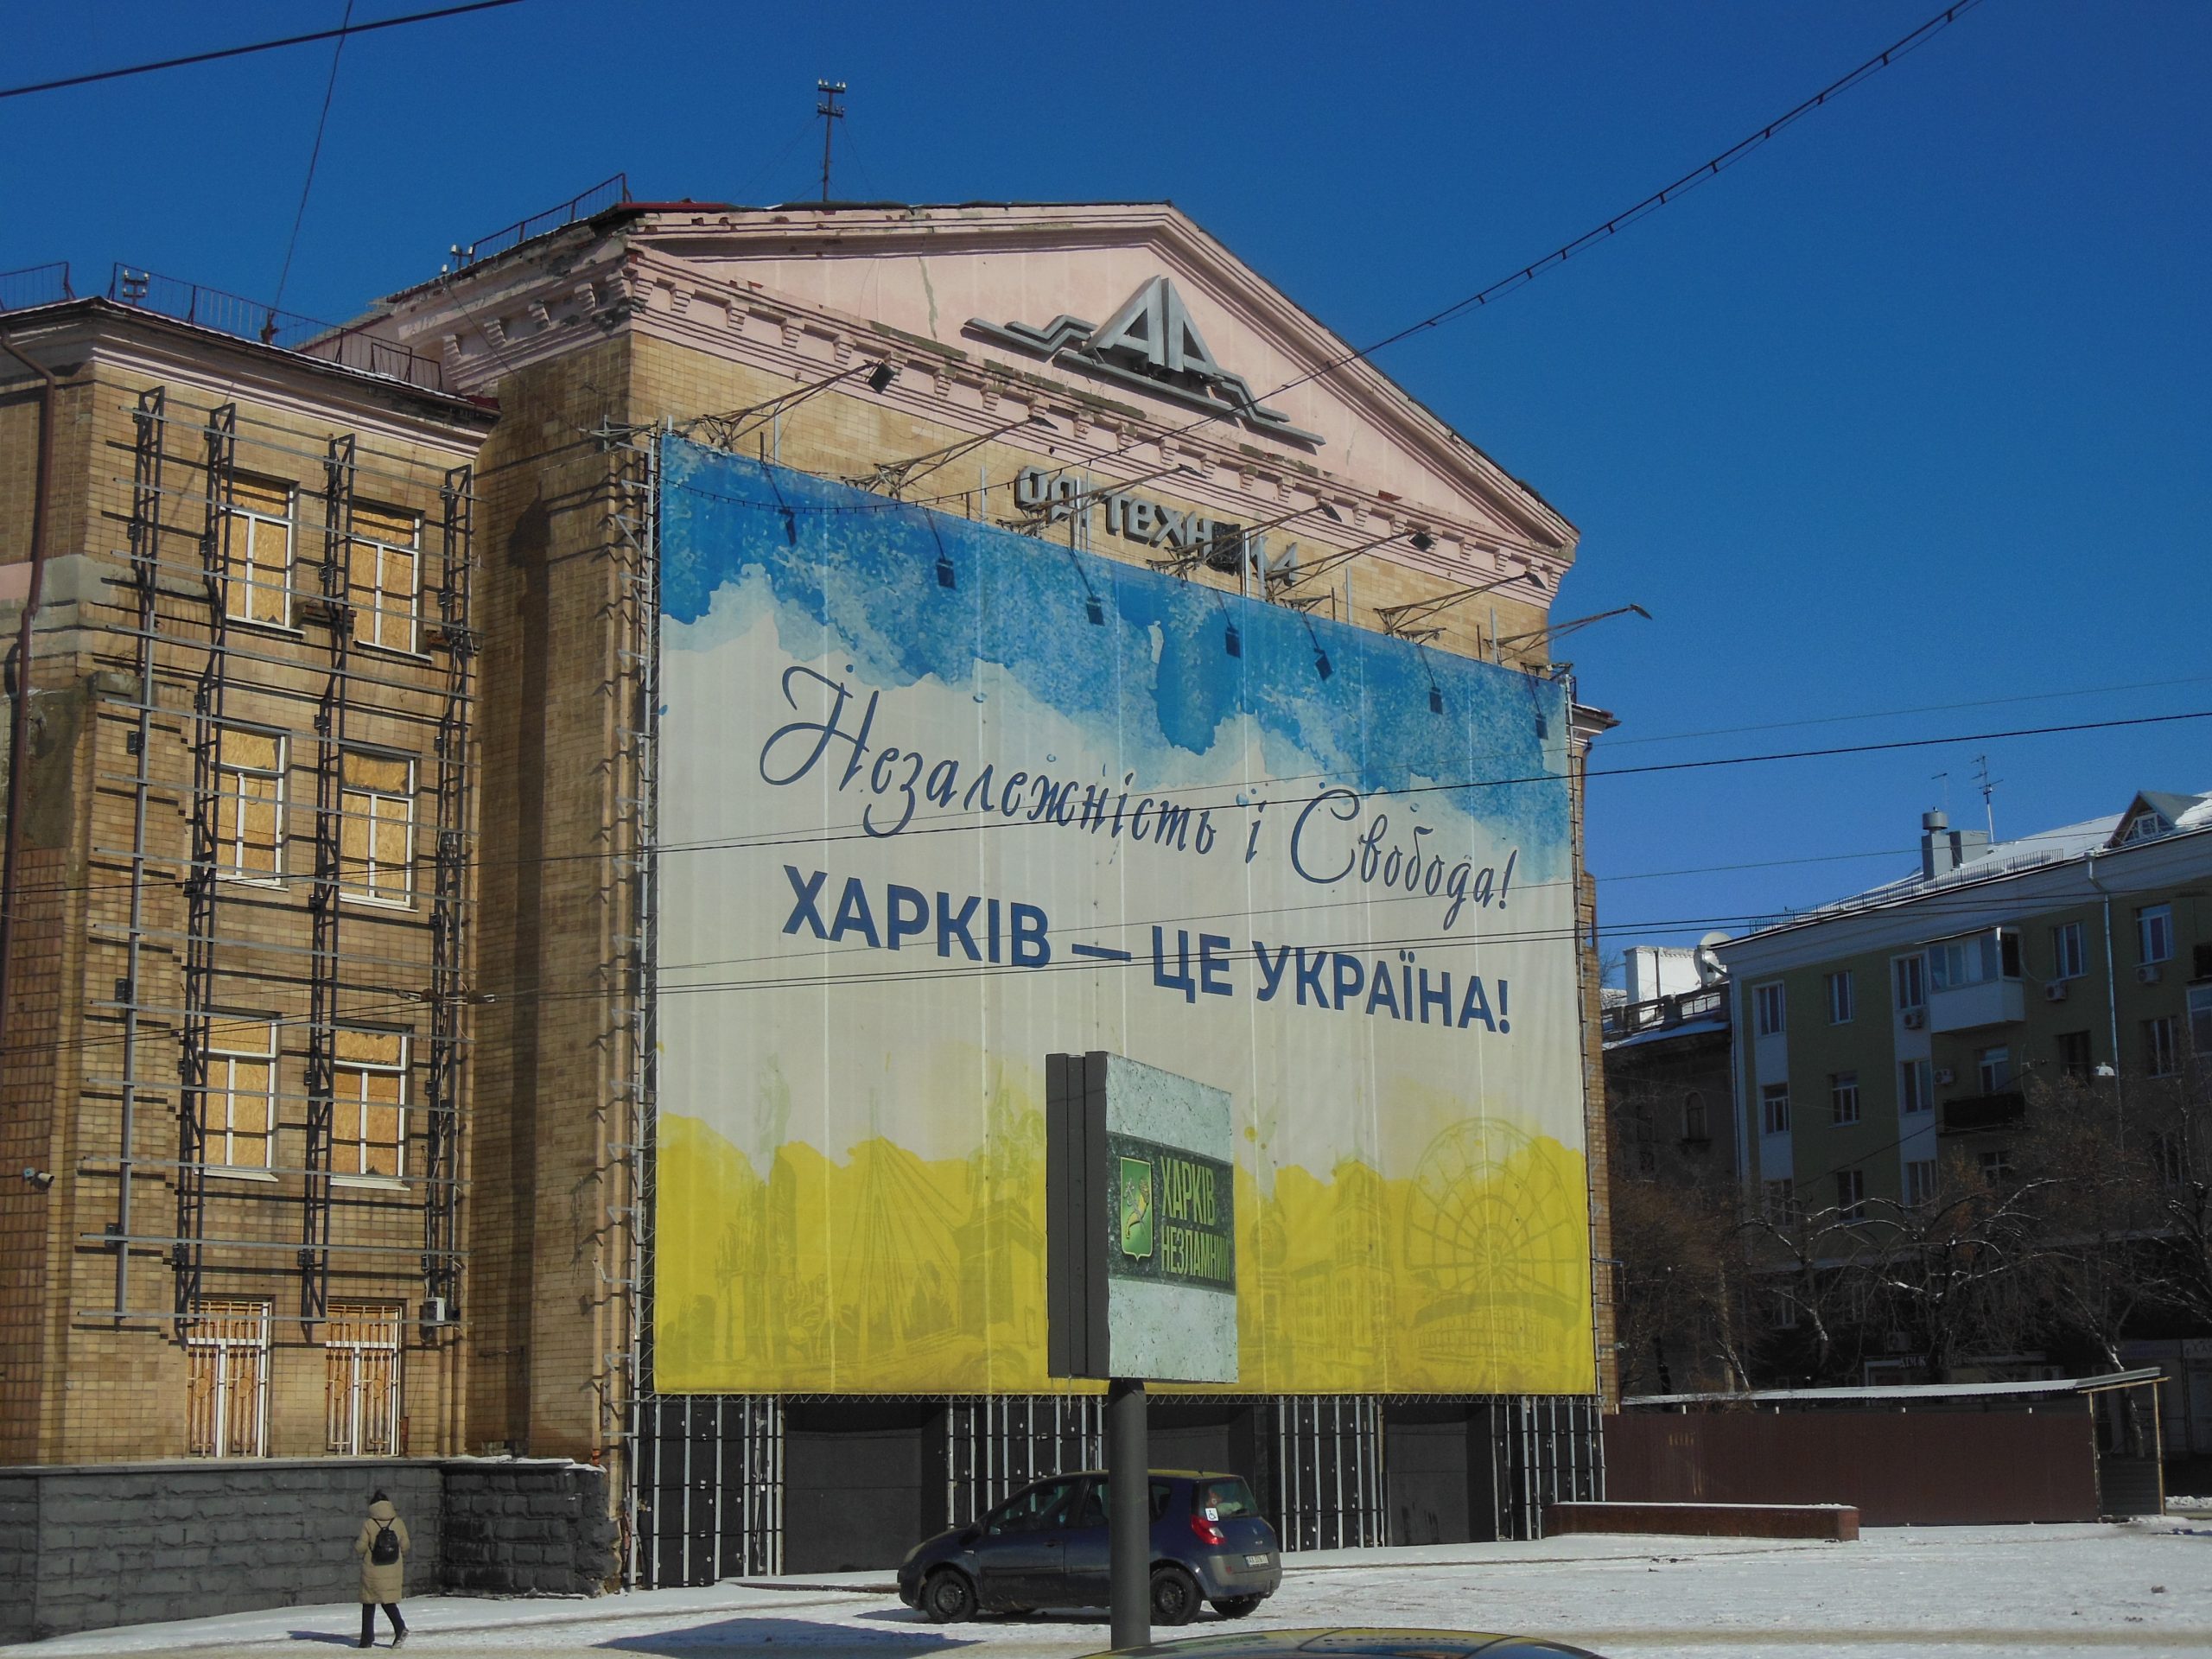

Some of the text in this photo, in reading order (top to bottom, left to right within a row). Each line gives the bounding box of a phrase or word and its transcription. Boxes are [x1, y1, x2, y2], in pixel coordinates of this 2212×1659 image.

[760, 665, 1518, 931] Незалежність і Свобода!
[782, 864, 1052, 969] ХАРКІВ
[1151, 925, 1234, 1004] ЦЕ
[1251, 939, 1511, 1035] УКРАЇНА!
[1160, 1155, 1217, 1226] ХАРКІВ
